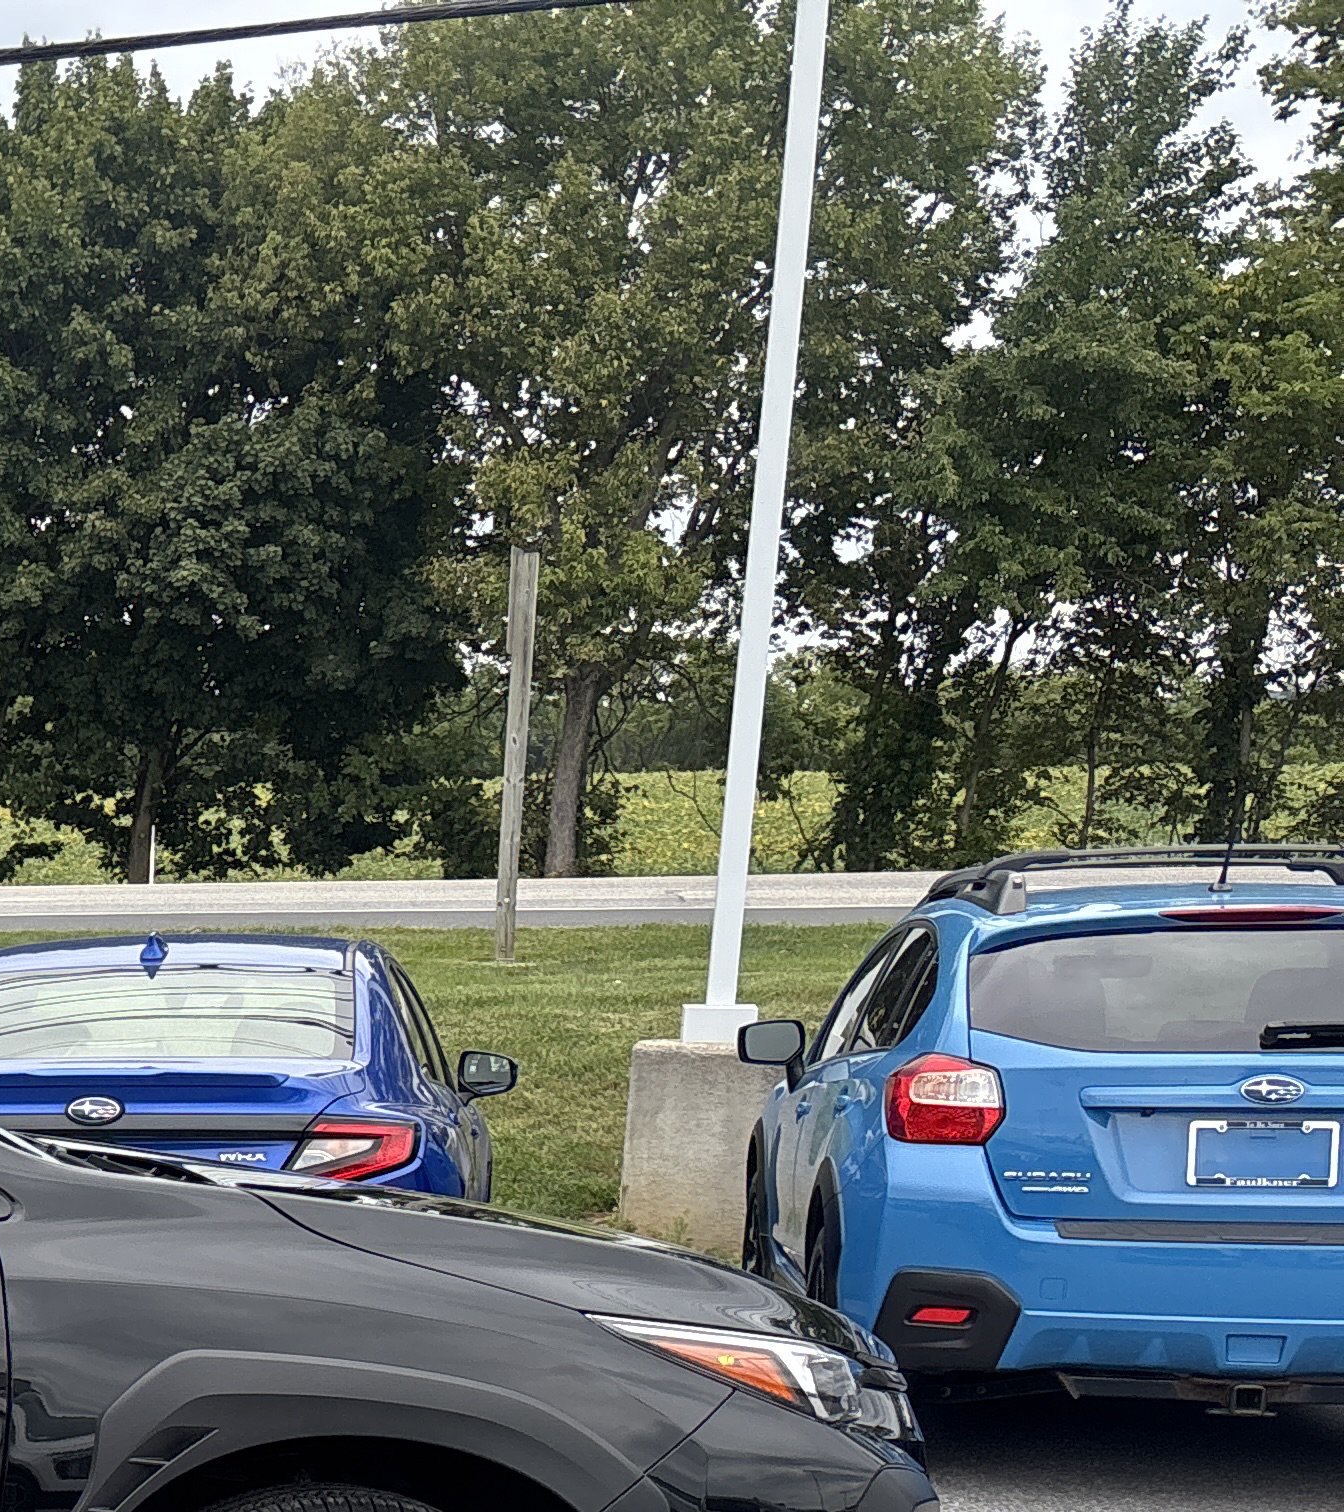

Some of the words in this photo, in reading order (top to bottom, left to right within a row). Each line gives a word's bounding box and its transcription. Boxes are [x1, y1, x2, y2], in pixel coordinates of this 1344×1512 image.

[219, 1151, 267, 1161] WRX
[1003, 1171, 1091, 1181] SUBARU
[1225, 1177, 1300, 1187] Faulkner
